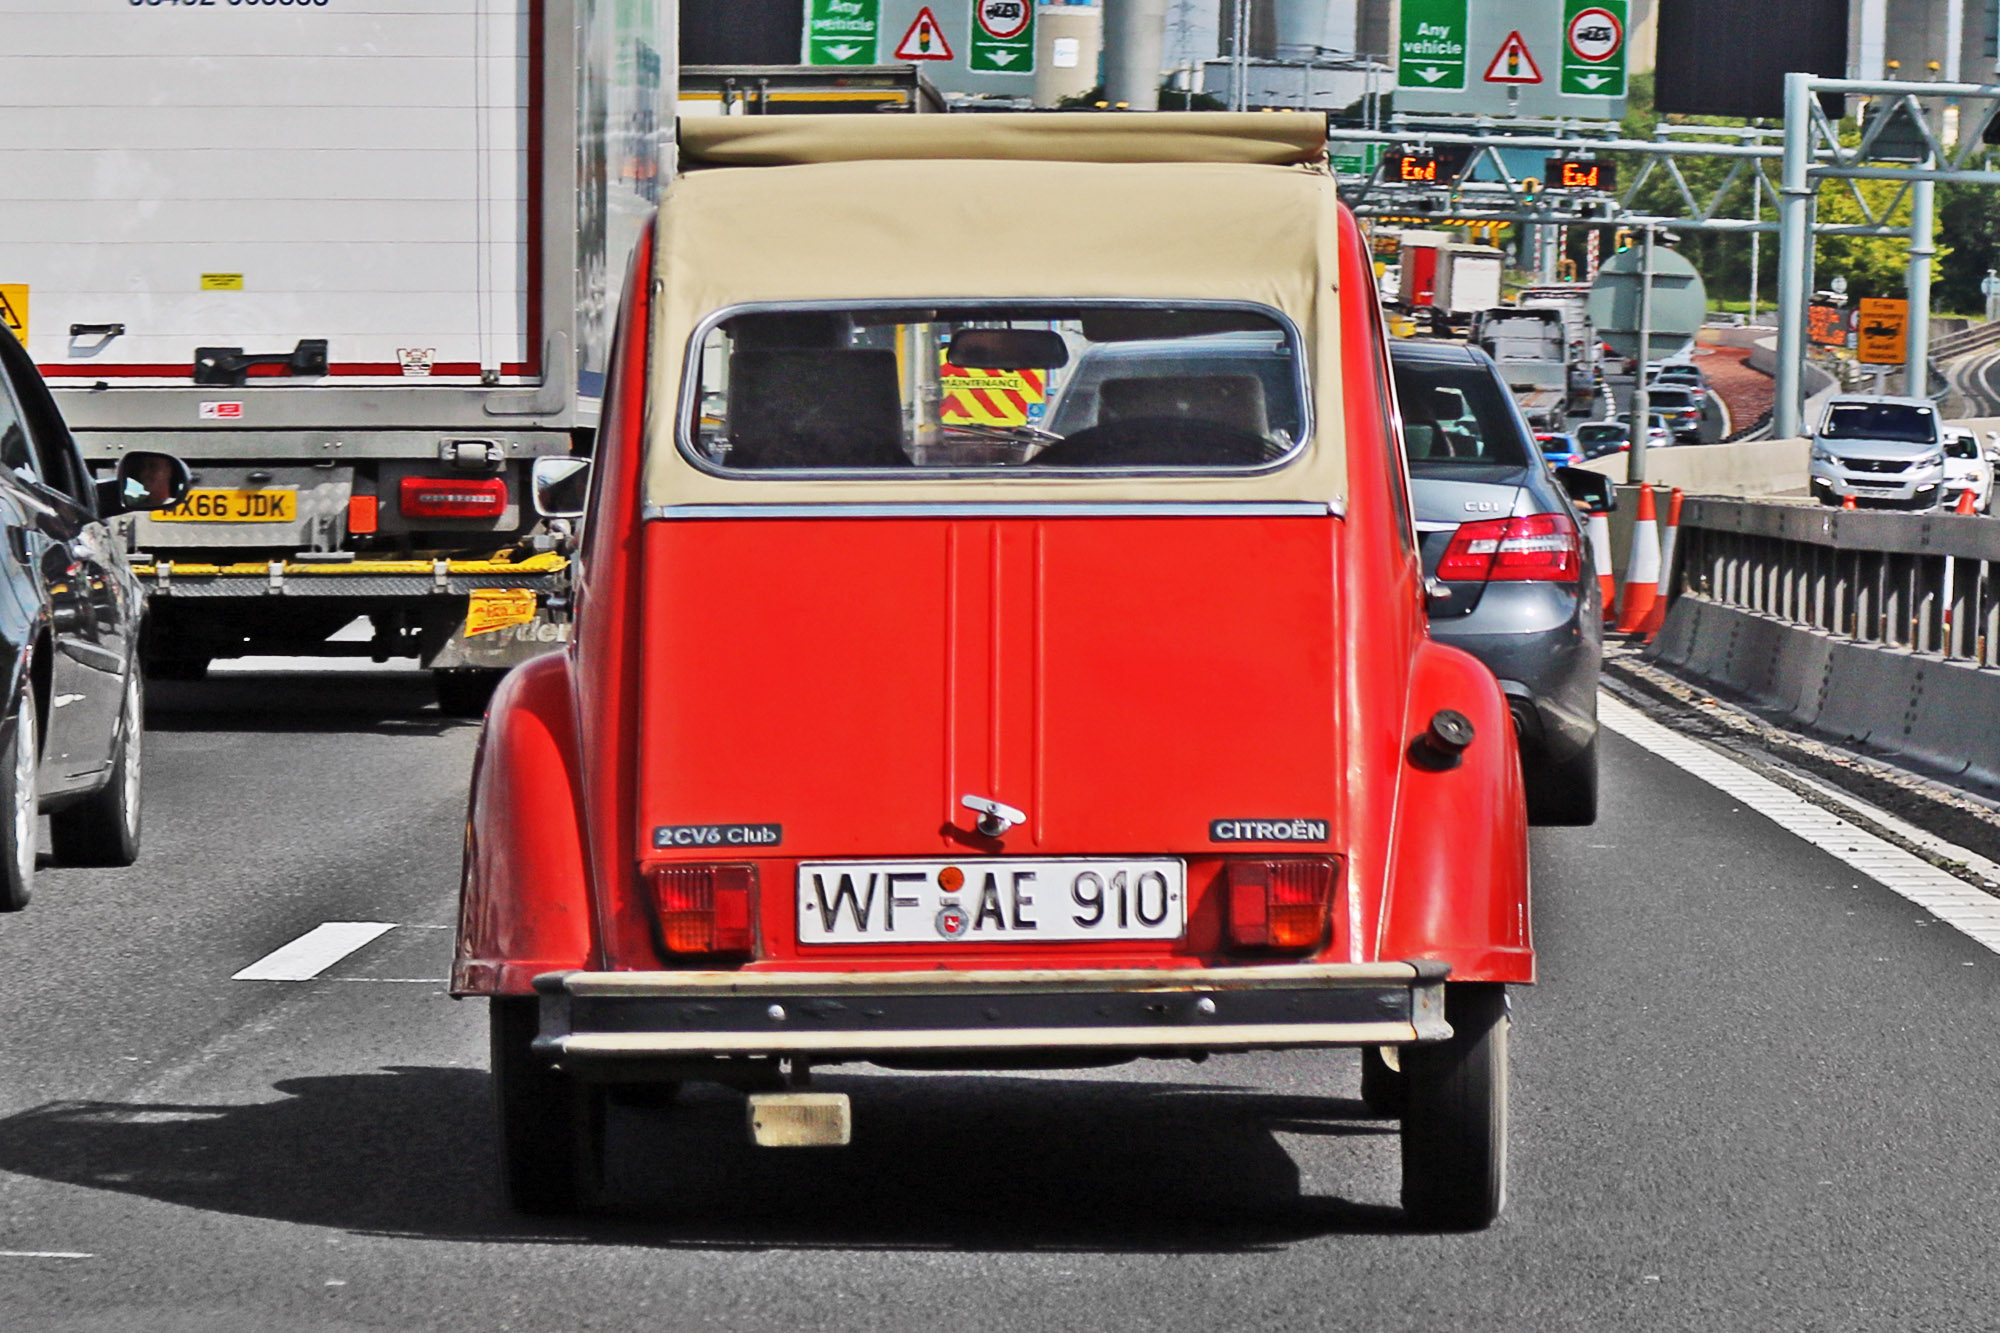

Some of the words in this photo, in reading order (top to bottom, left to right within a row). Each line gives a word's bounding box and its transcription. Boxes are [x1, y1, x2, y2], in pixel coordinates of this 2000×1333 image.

[826, 0, 863, 15] Any
[813, 18, 874, 31] vehicle
[1417, 22, 1450, 39] Any
[1403, 40, 1462, 54] vehicle
[1402, 156, 1436, 180] End
[1562, 163, 1598, 186] End
[163, 495, 228, 517] X66
[237, 494, 285, 517] JDK
[1464, 501, 1499, 512] CDI
[658, 827, 721, 845] 2CV6
[727, 826, 777, 843] Club
[1215, 818, 1325, 840] CITROËN
[812, 872, 928, 933] WF
[972, 871, 1038, 931] AE
[1070, 869, 1169, 929] 910
